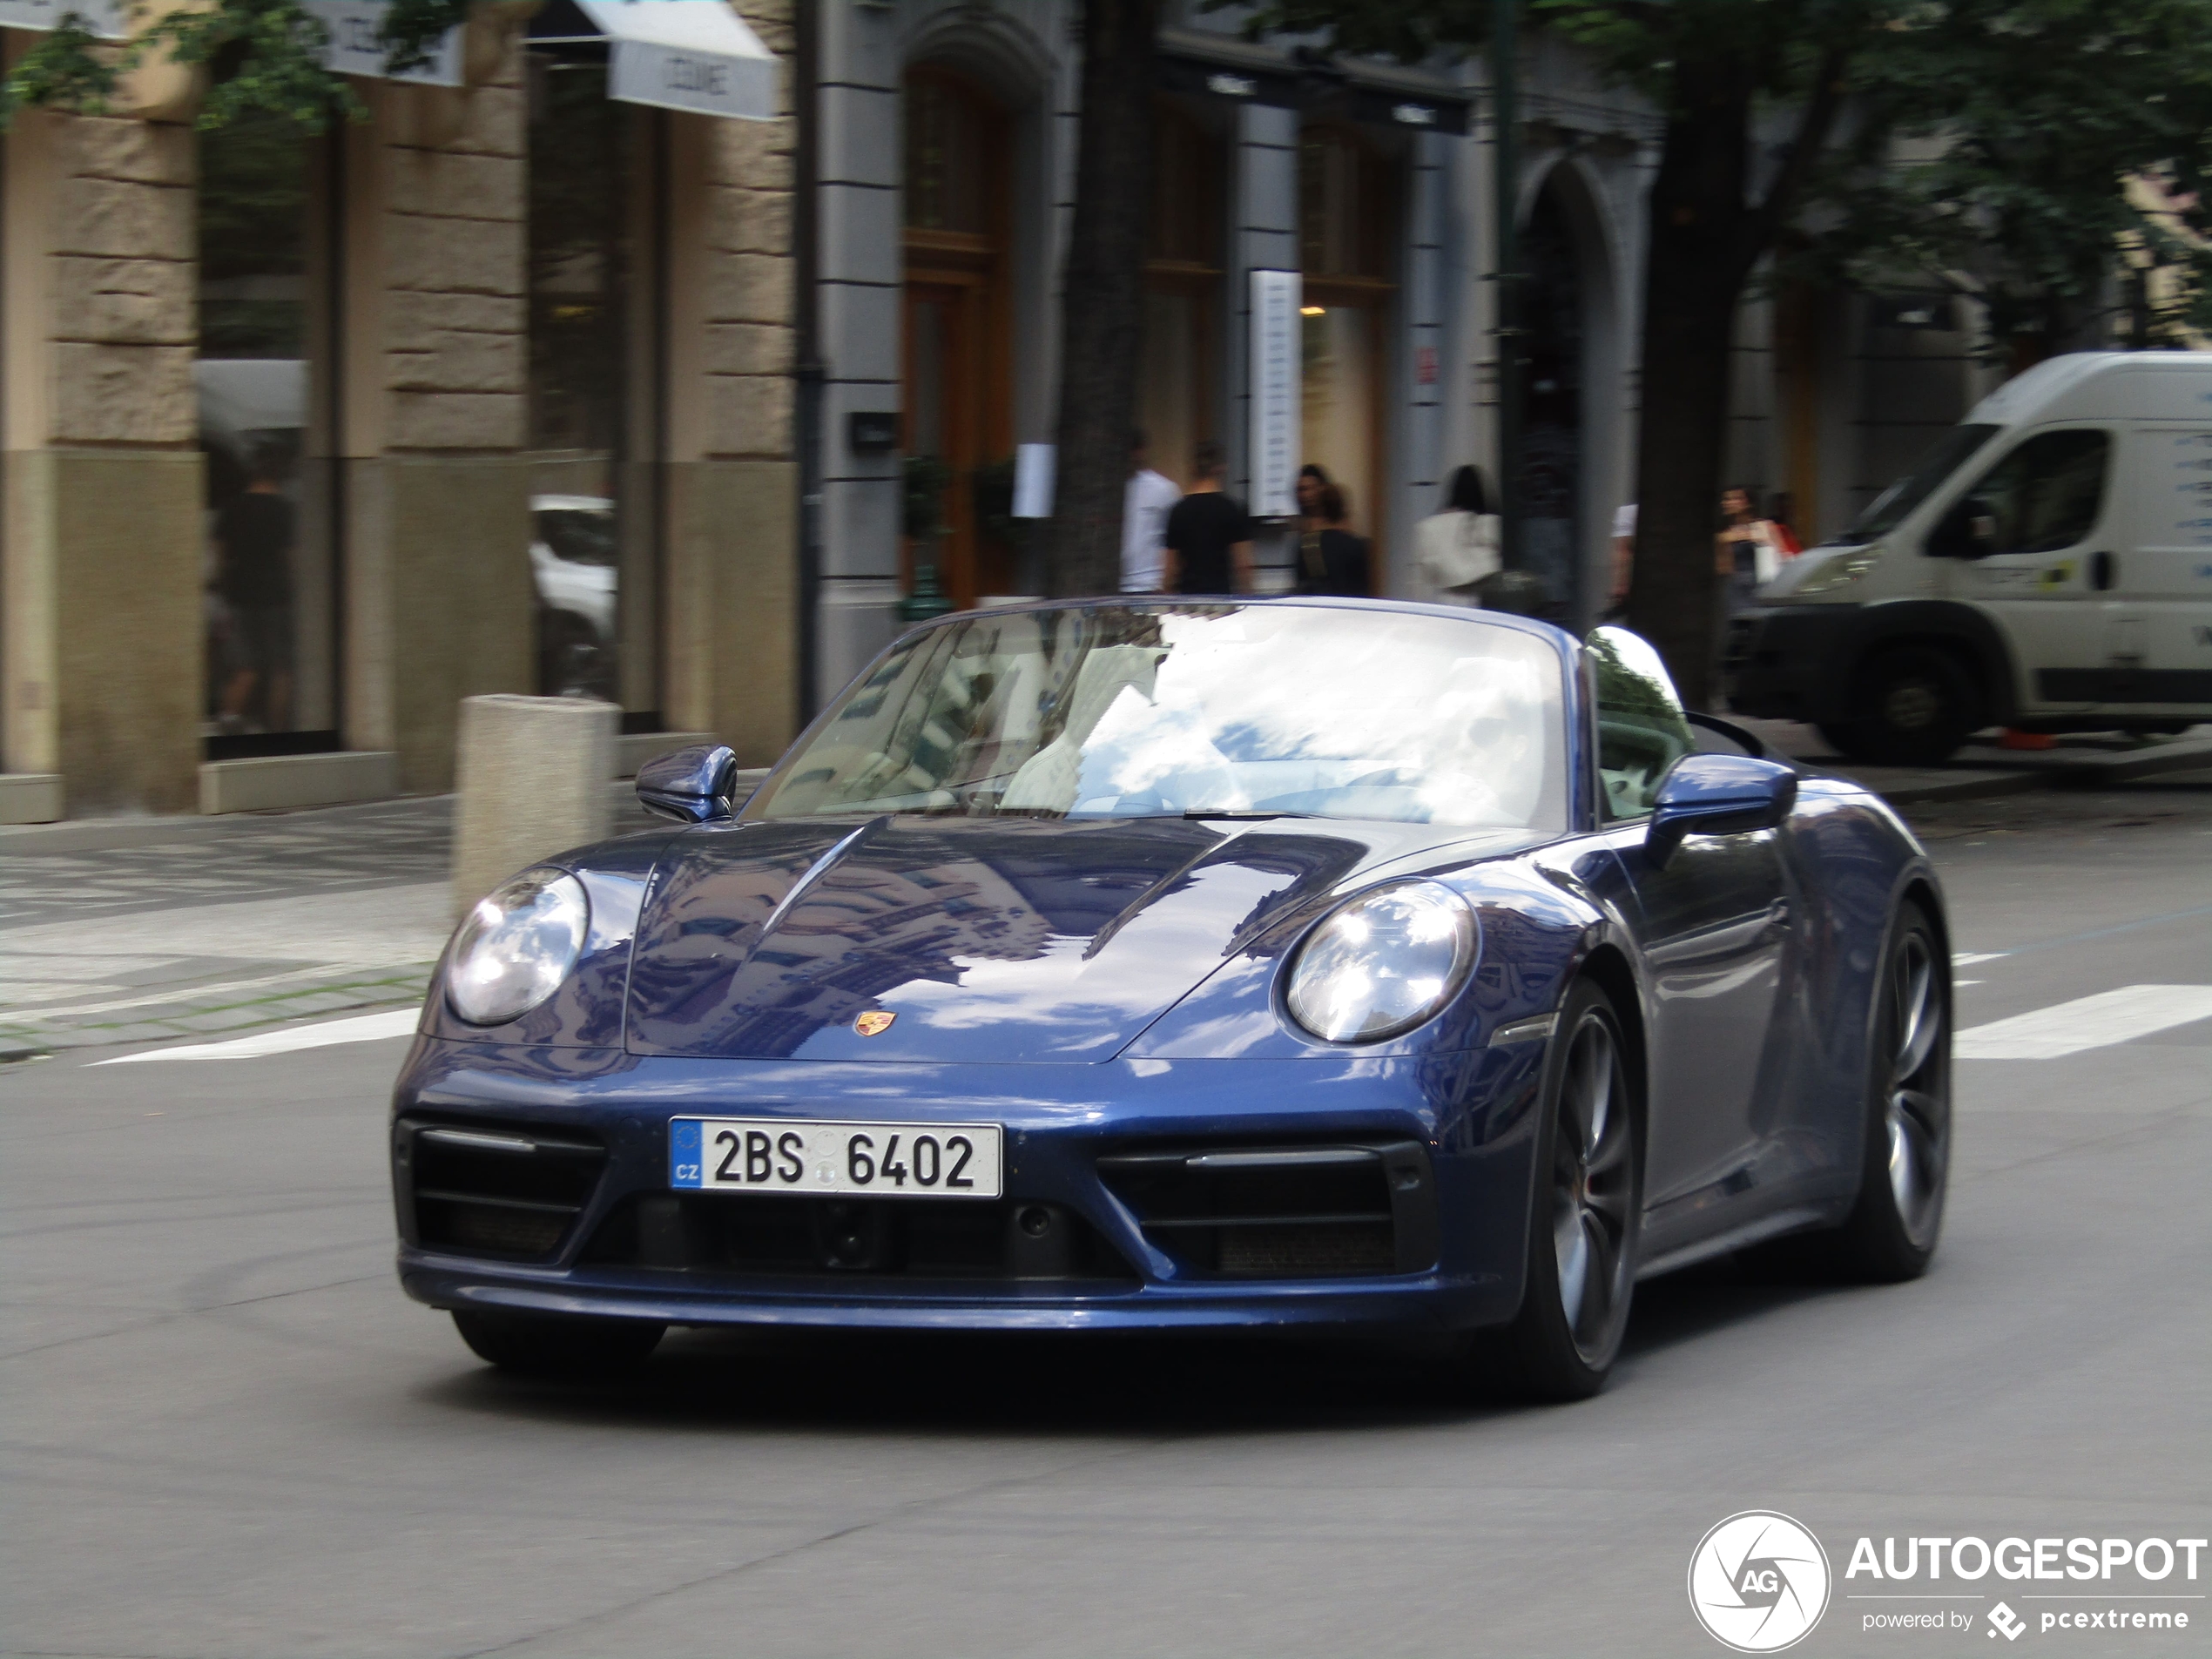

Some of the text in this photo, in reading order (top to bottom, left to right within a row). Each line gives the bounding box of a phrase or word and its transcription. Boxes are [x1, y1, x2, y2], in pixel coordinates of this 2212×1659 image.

[676, 1163, 700, 1180] CZ
[715, 1130, 974, 1187] 2BS 6402
